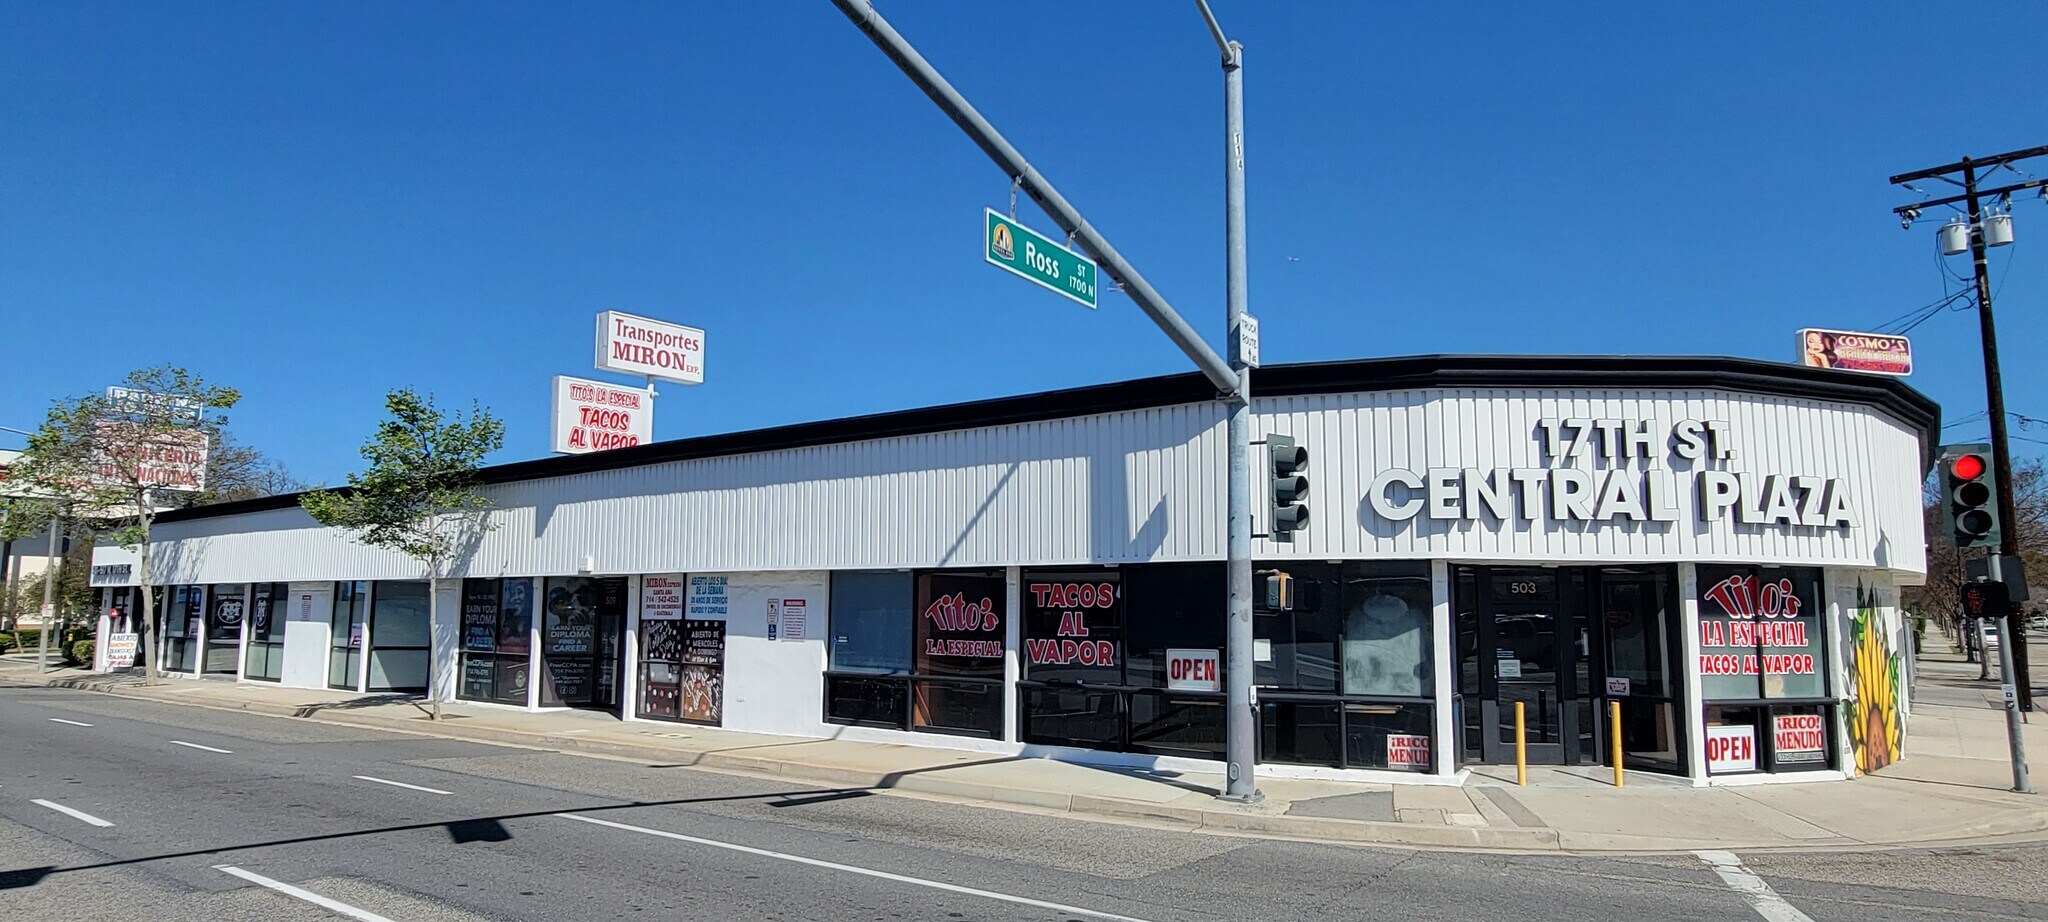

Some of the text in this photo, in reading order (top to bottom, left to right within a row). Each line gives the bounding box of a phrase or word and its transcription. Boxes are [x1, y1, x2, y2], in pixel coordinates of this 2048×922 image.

[1026, 241, 1059, 279] Ross
[1077, 264, 1085, 277] ST
[1069, 275, 1094, 297] 1700 N
[615, 318, 699, 352] Transportes
[612, 341, 700, 374] MIRON EXP.
[570, 383, 640, 409] TITO'S LA ESPECIAL
[580, 407, 630, 431] TACOS
[568, 427, 639, 450] AL VAPOR
[1539, 418, 1737, 460] 17TH ST.
[1371, 467, 1860, 529] CENTRAL PLAZA
[646, 577, 667, 588] MIRON
[1511, 582, 1536, 594] 503
[1030, 583, 1114, 608] TACOS
[466, 605, 497, 613] EARN YOUR
[466, 614, 496, 625] DIPLOMA
[925, 592, 999, 631] Tito's
[691, 631, 711, 639] ABIERTO
[1058, 612, 1089, 636] AL
[1701, 620, 1725, 647] LA
[926, 639, 1003, 658] LA ESPECIAL
[1027, 639, 1114, 666] VAPOR
[1171, 658, 1216, 681] OPEN
[1700, 654, 1815, 675] TACOS AL VAPOR
[1777, 716, 1820, 730] ¡RICO!
[1709, 736, 1751, 761] OPEN
[1776, 730, 1823, 750] MENUDO
